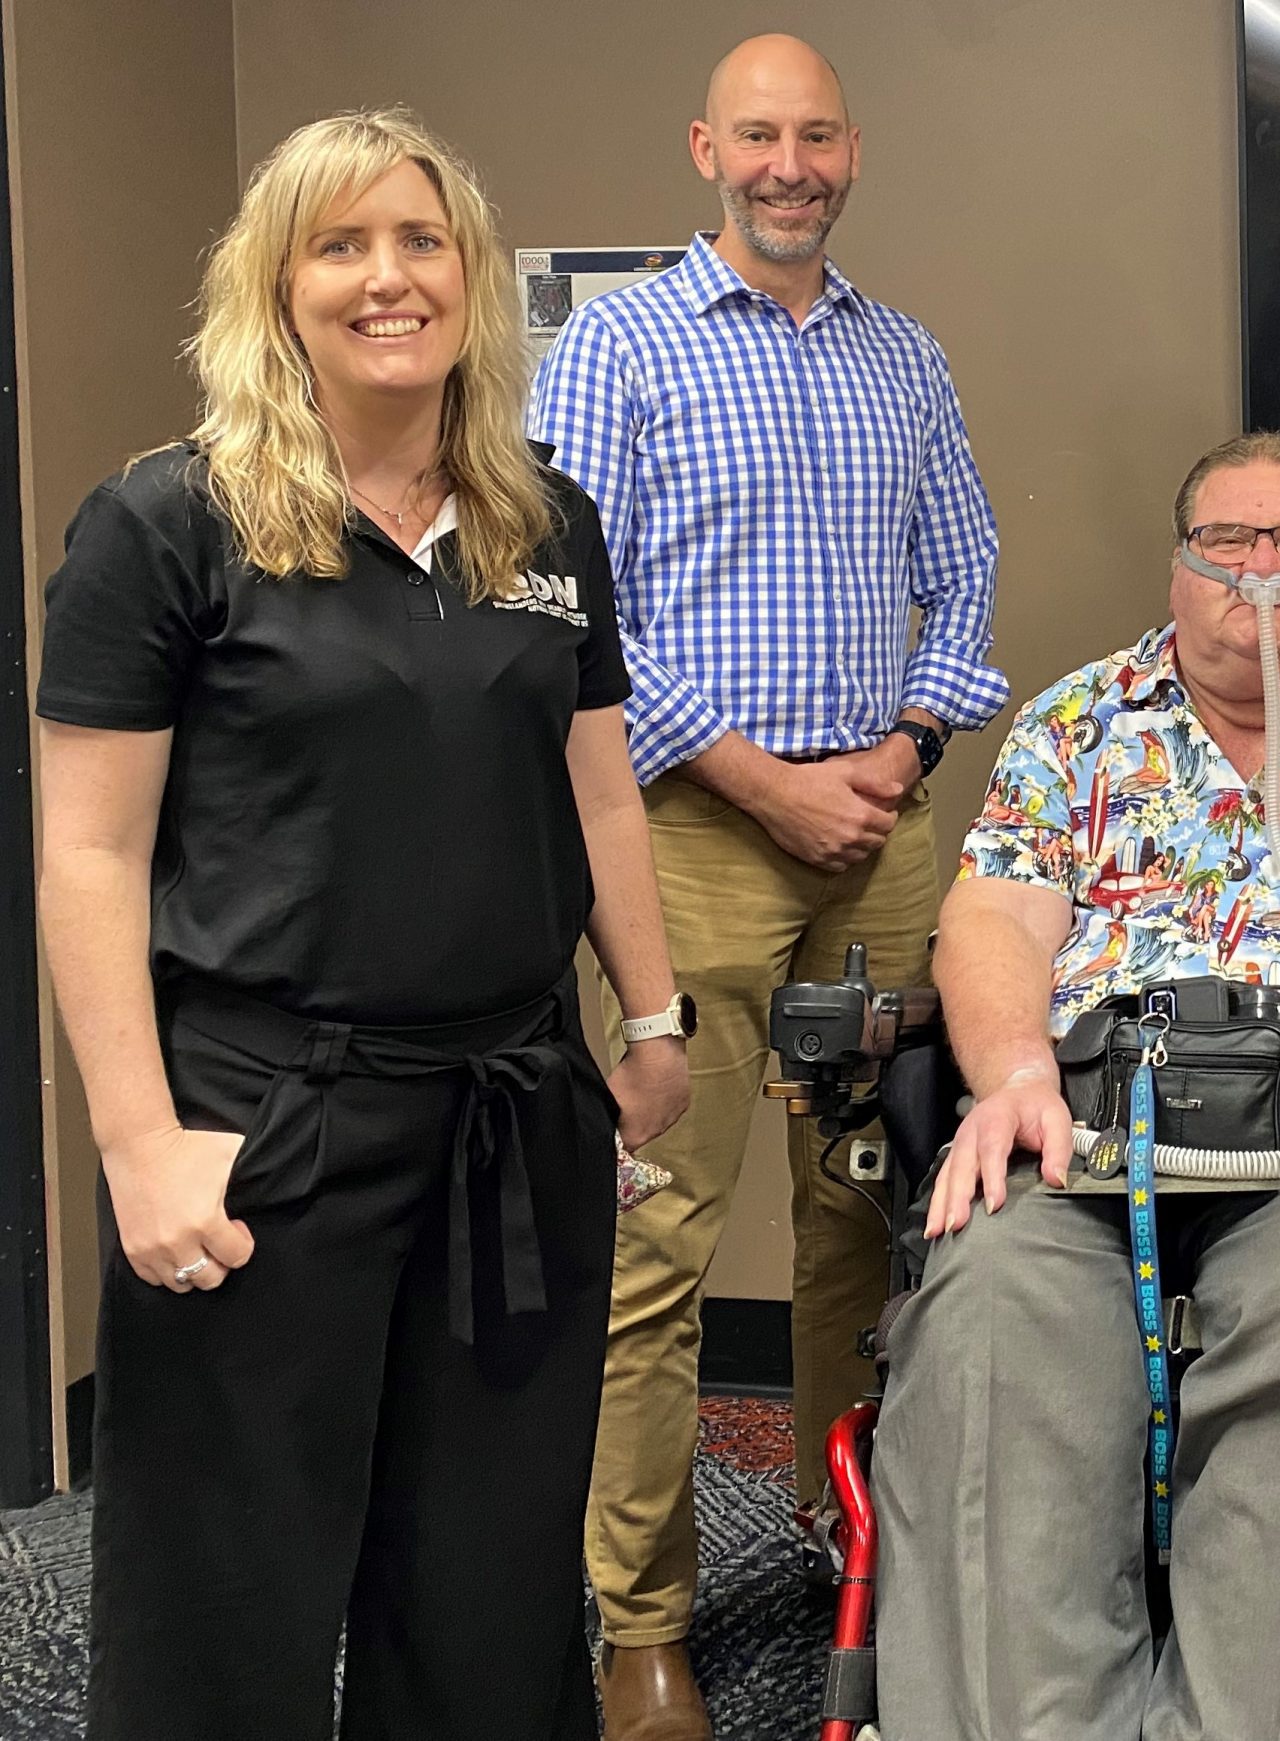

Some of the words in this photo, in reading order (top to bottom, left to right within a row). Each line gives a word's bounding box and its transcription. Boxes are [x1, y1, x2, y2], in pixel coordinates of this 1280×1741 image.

[1135, 1071, 1147, 1114] BOSS
[1133, 1139, 1148, 1182] BOSS
[1135, 1211, 1152, 1257] BOSS
[1141, 1284, 1158, 1331] BOSS
[1148, 1356, 1163, 1403] BOSS
[1153, 1429, 1168, 1476] BOSS
